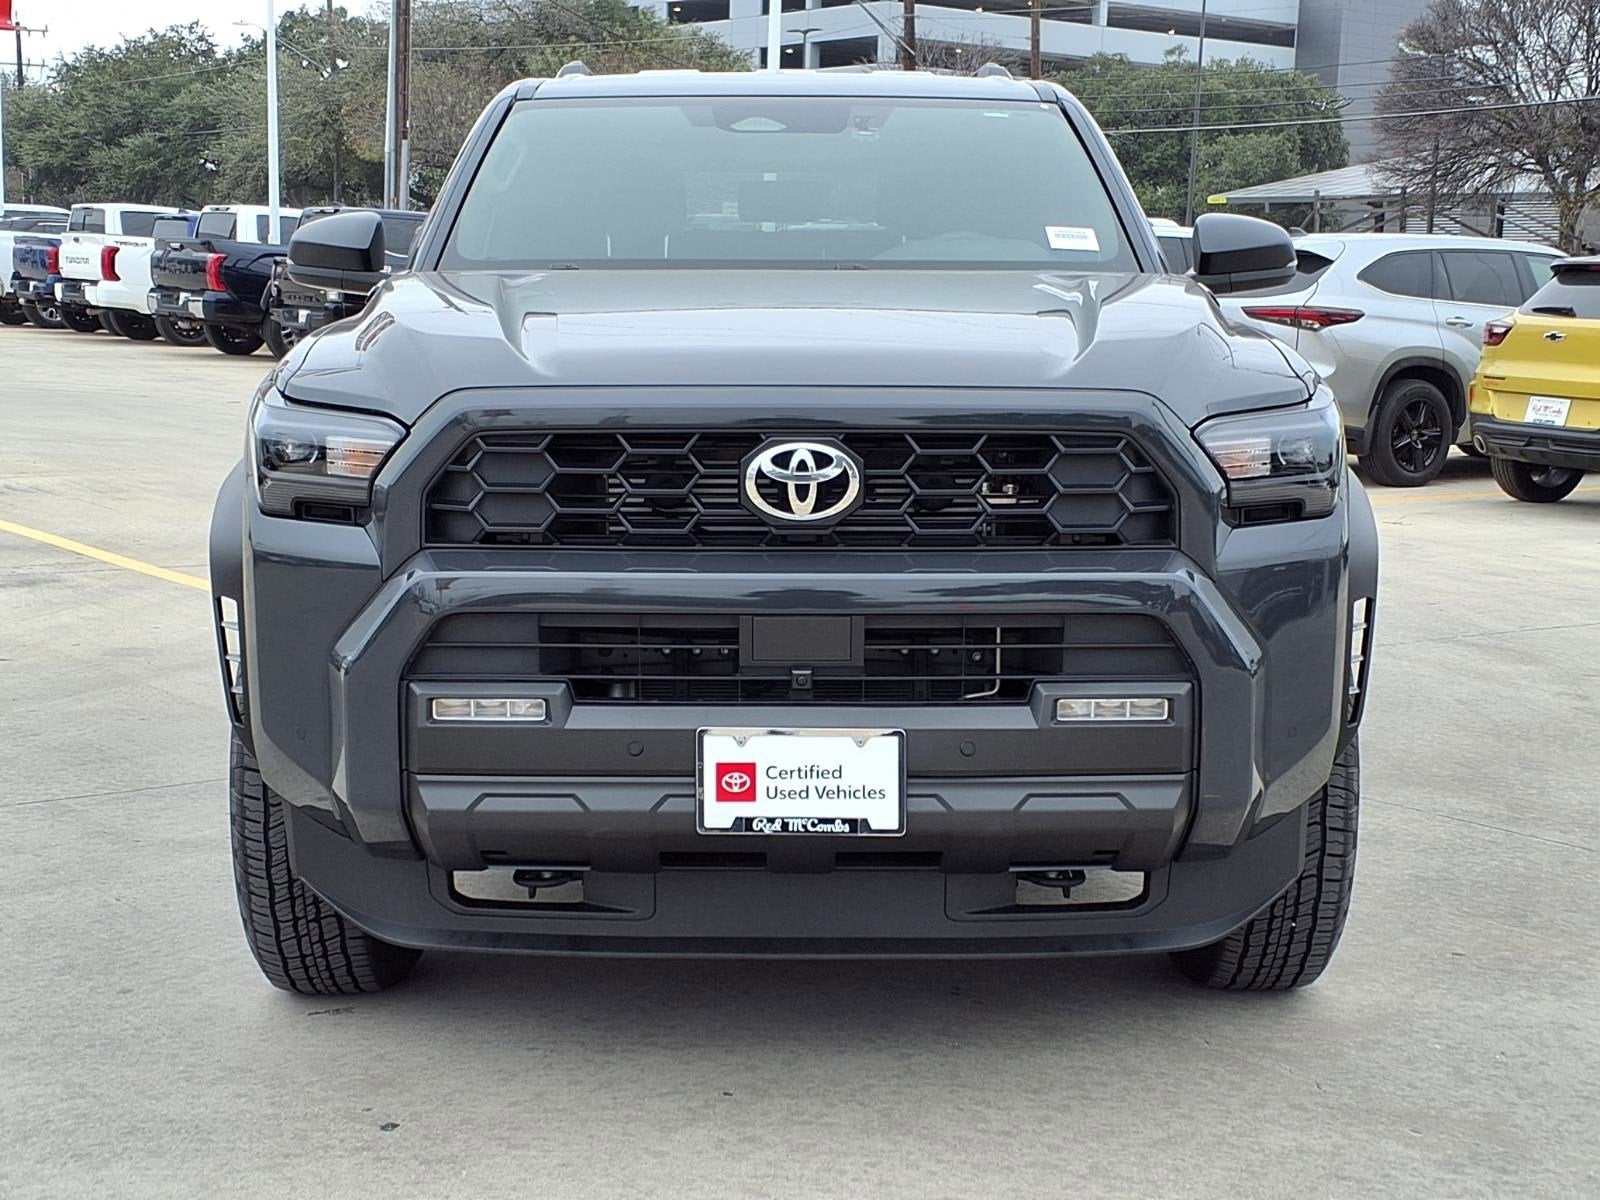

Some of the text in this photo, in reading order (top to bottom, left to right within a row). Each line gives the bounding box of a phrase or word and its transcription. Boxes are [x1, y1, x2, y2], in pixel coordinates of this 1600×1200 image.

[765, 764, 842, 780] Certified
[766, 784, 886, 800] Used Vehicles
[752, 816, 850, 834] Red McCombs
